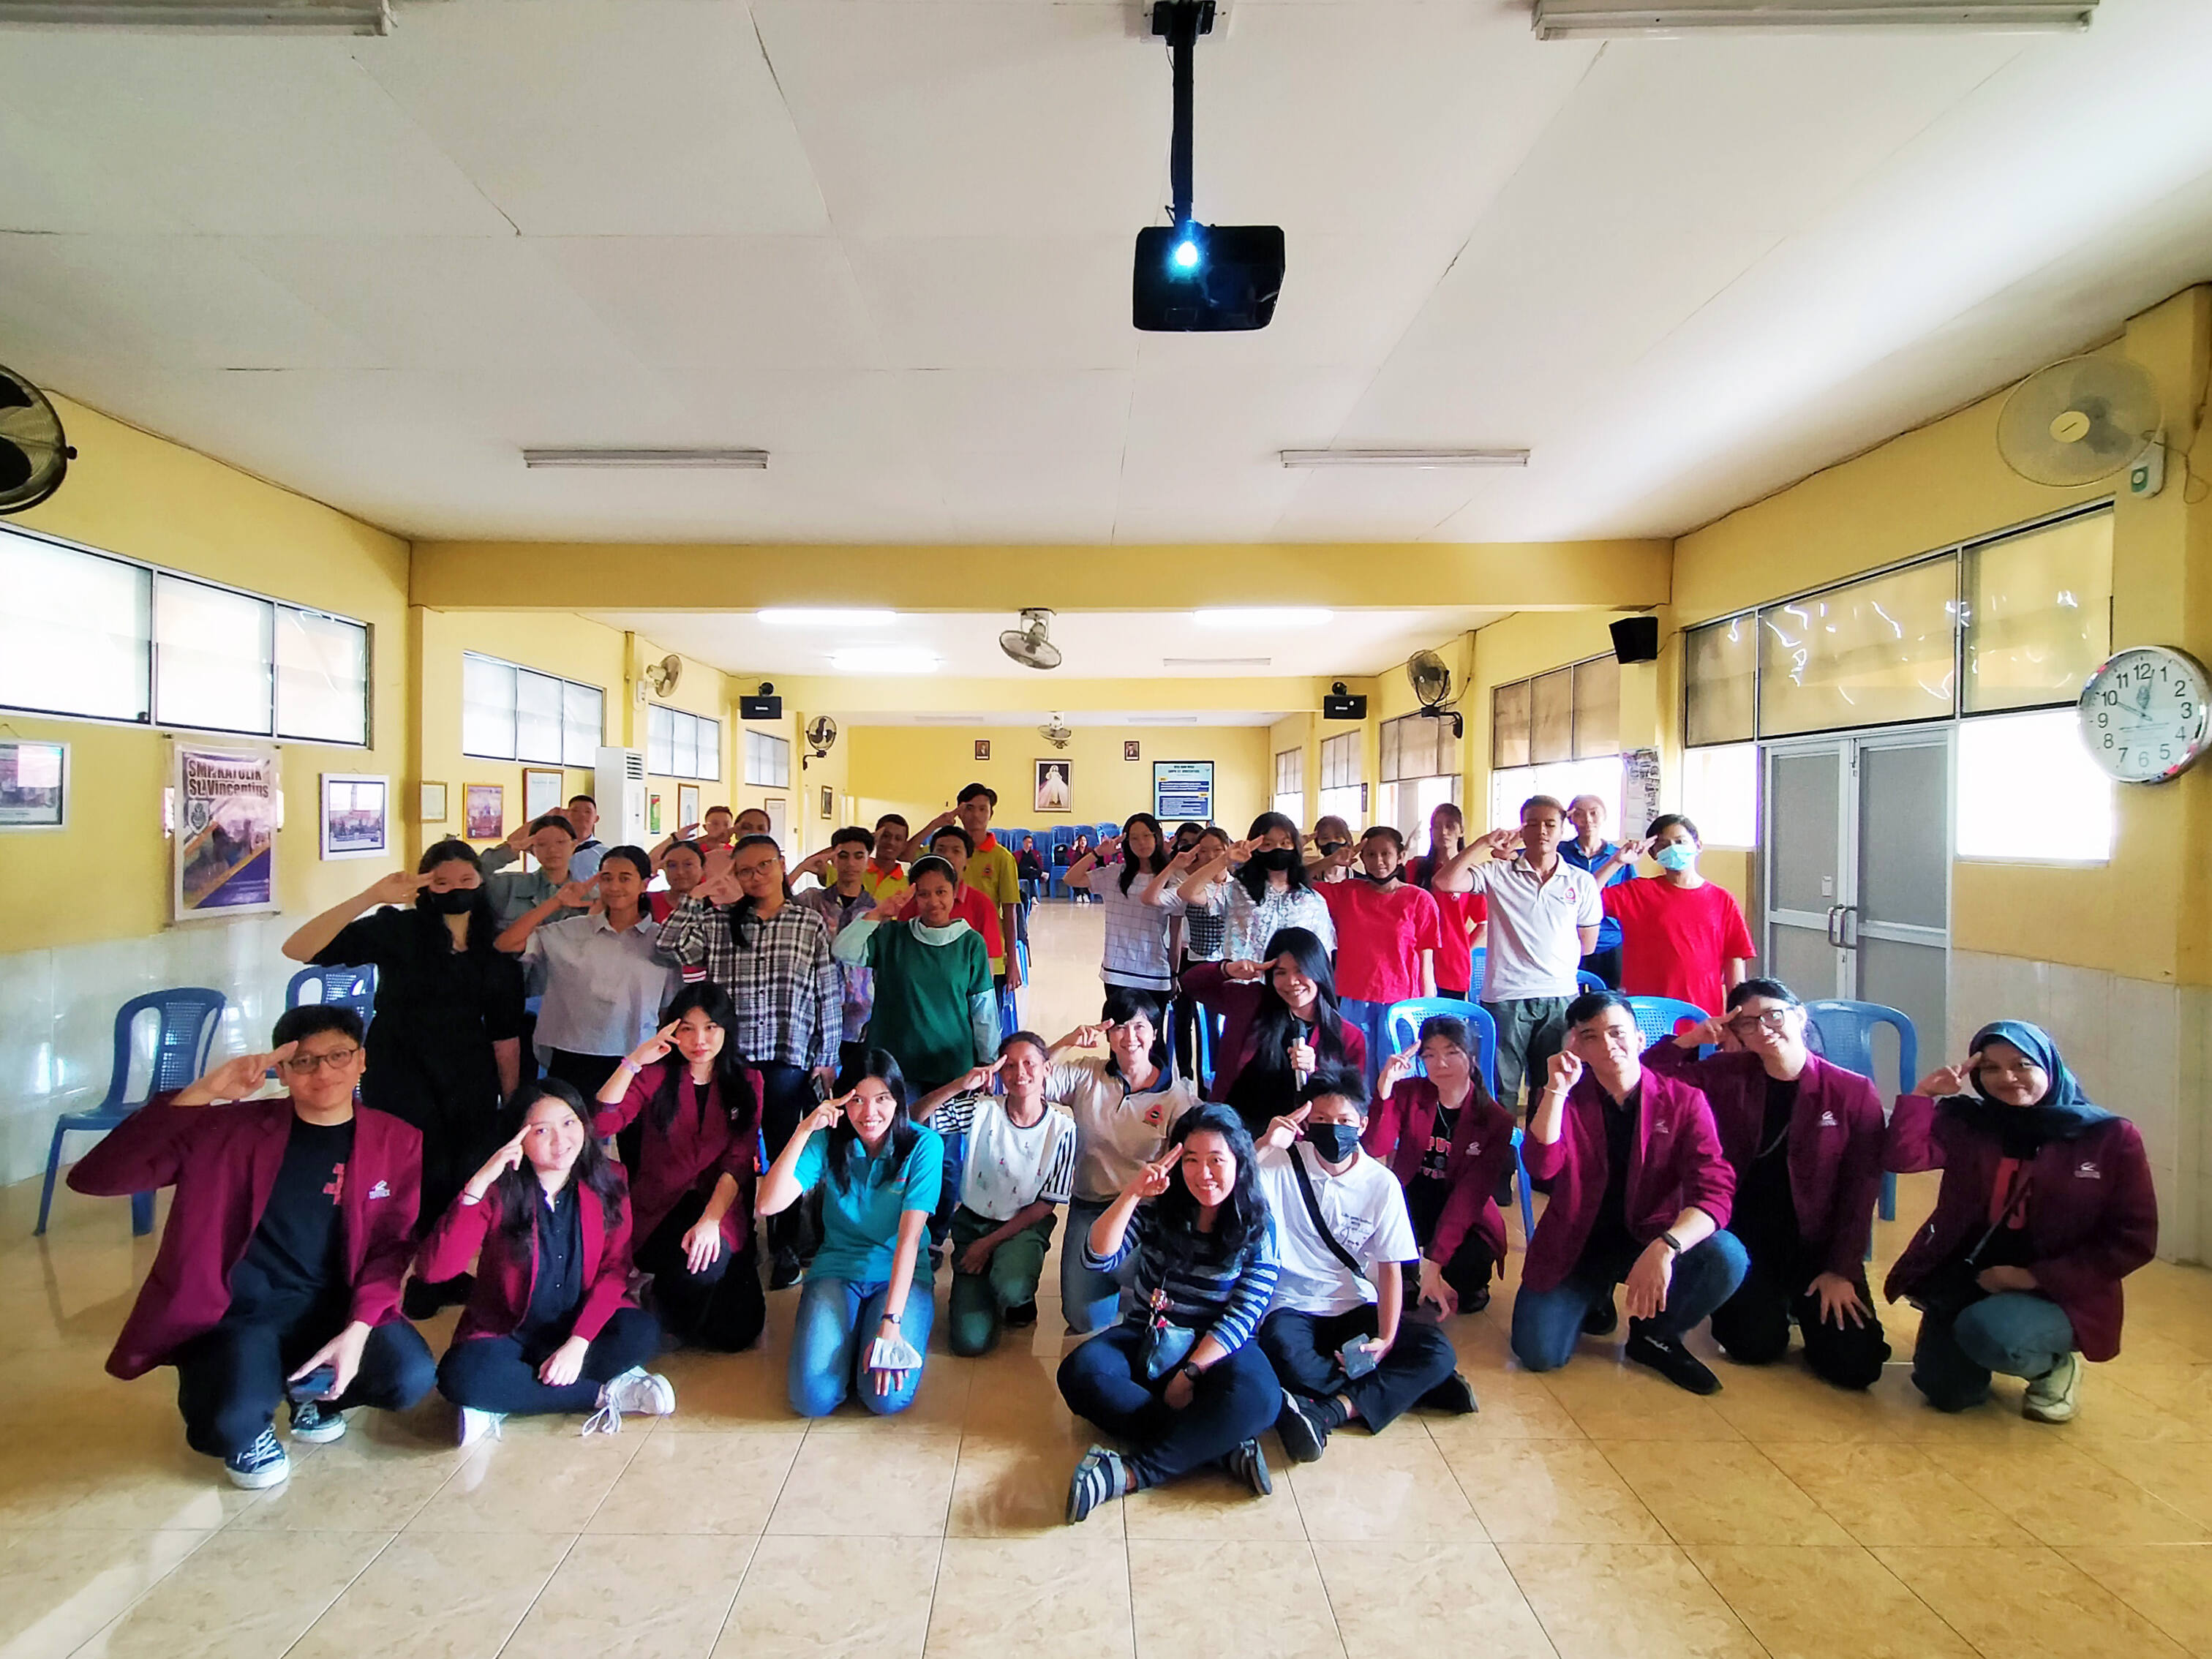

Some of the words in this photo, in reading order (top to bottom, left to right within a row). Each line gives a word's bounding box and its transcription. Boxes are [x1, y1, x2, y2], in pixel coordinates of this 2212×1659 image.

[2133, 663, 2151, 680] 12
[2160, 666, 2167, 682] 1
[2116, 672, 2129, 689] 11
[2174, 680, 2186, 697] 2
[2101, 690, 2118, 707] 10
[2181, 701, 2192, 719] 3
[2098, 712, 2108, 729] 9
[2103, 733, 2114, 749] 8
[2175, 726, 2186, 741] 4
[2118, 747, 2129, 762] 7
[2138, 751, 2149, 767] 6
[2159, 743, 2171, 760] 5
[207, 780, 269, 798] Vincentius
